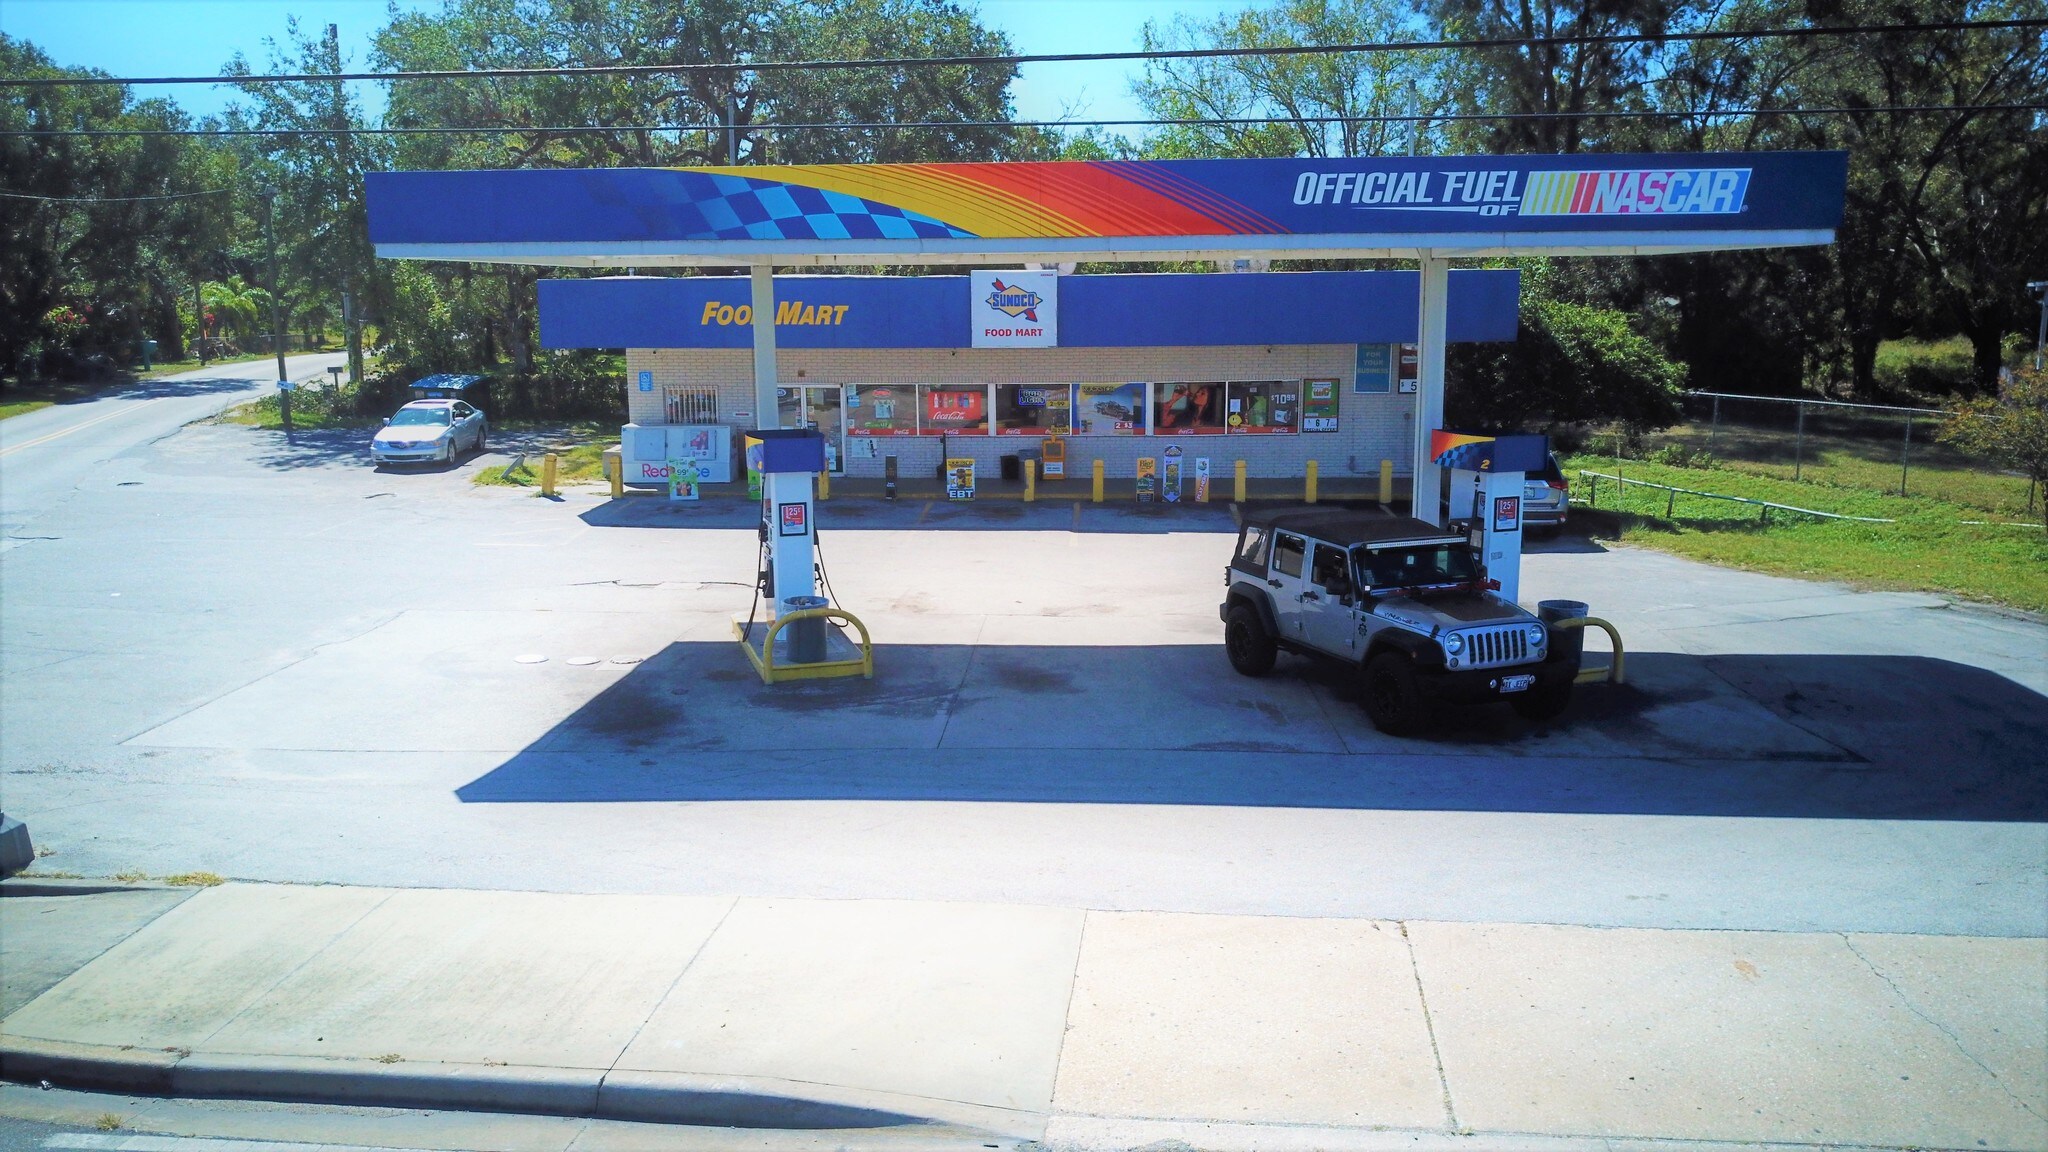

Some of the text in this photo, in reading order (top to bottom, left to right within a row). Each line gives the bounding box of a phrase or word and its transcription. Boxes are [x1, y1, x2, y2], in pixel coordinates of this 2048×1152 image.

[1293, 170, 1521, 205] OFFICIAL FUEL
[1589, 171, 1740, 213] NASCAR
[1479, 204, 1519, 216] OF
[992, 294, 1035, 307] SUNOCO
[701, 301, 754, 325] FOO
[985, 328, 1043, 337] FOOD MART
[1410, 381, 1417, 392] 5
[1480, 459, 1490, 469] 2
[949, 490, 974, 498] EBT
